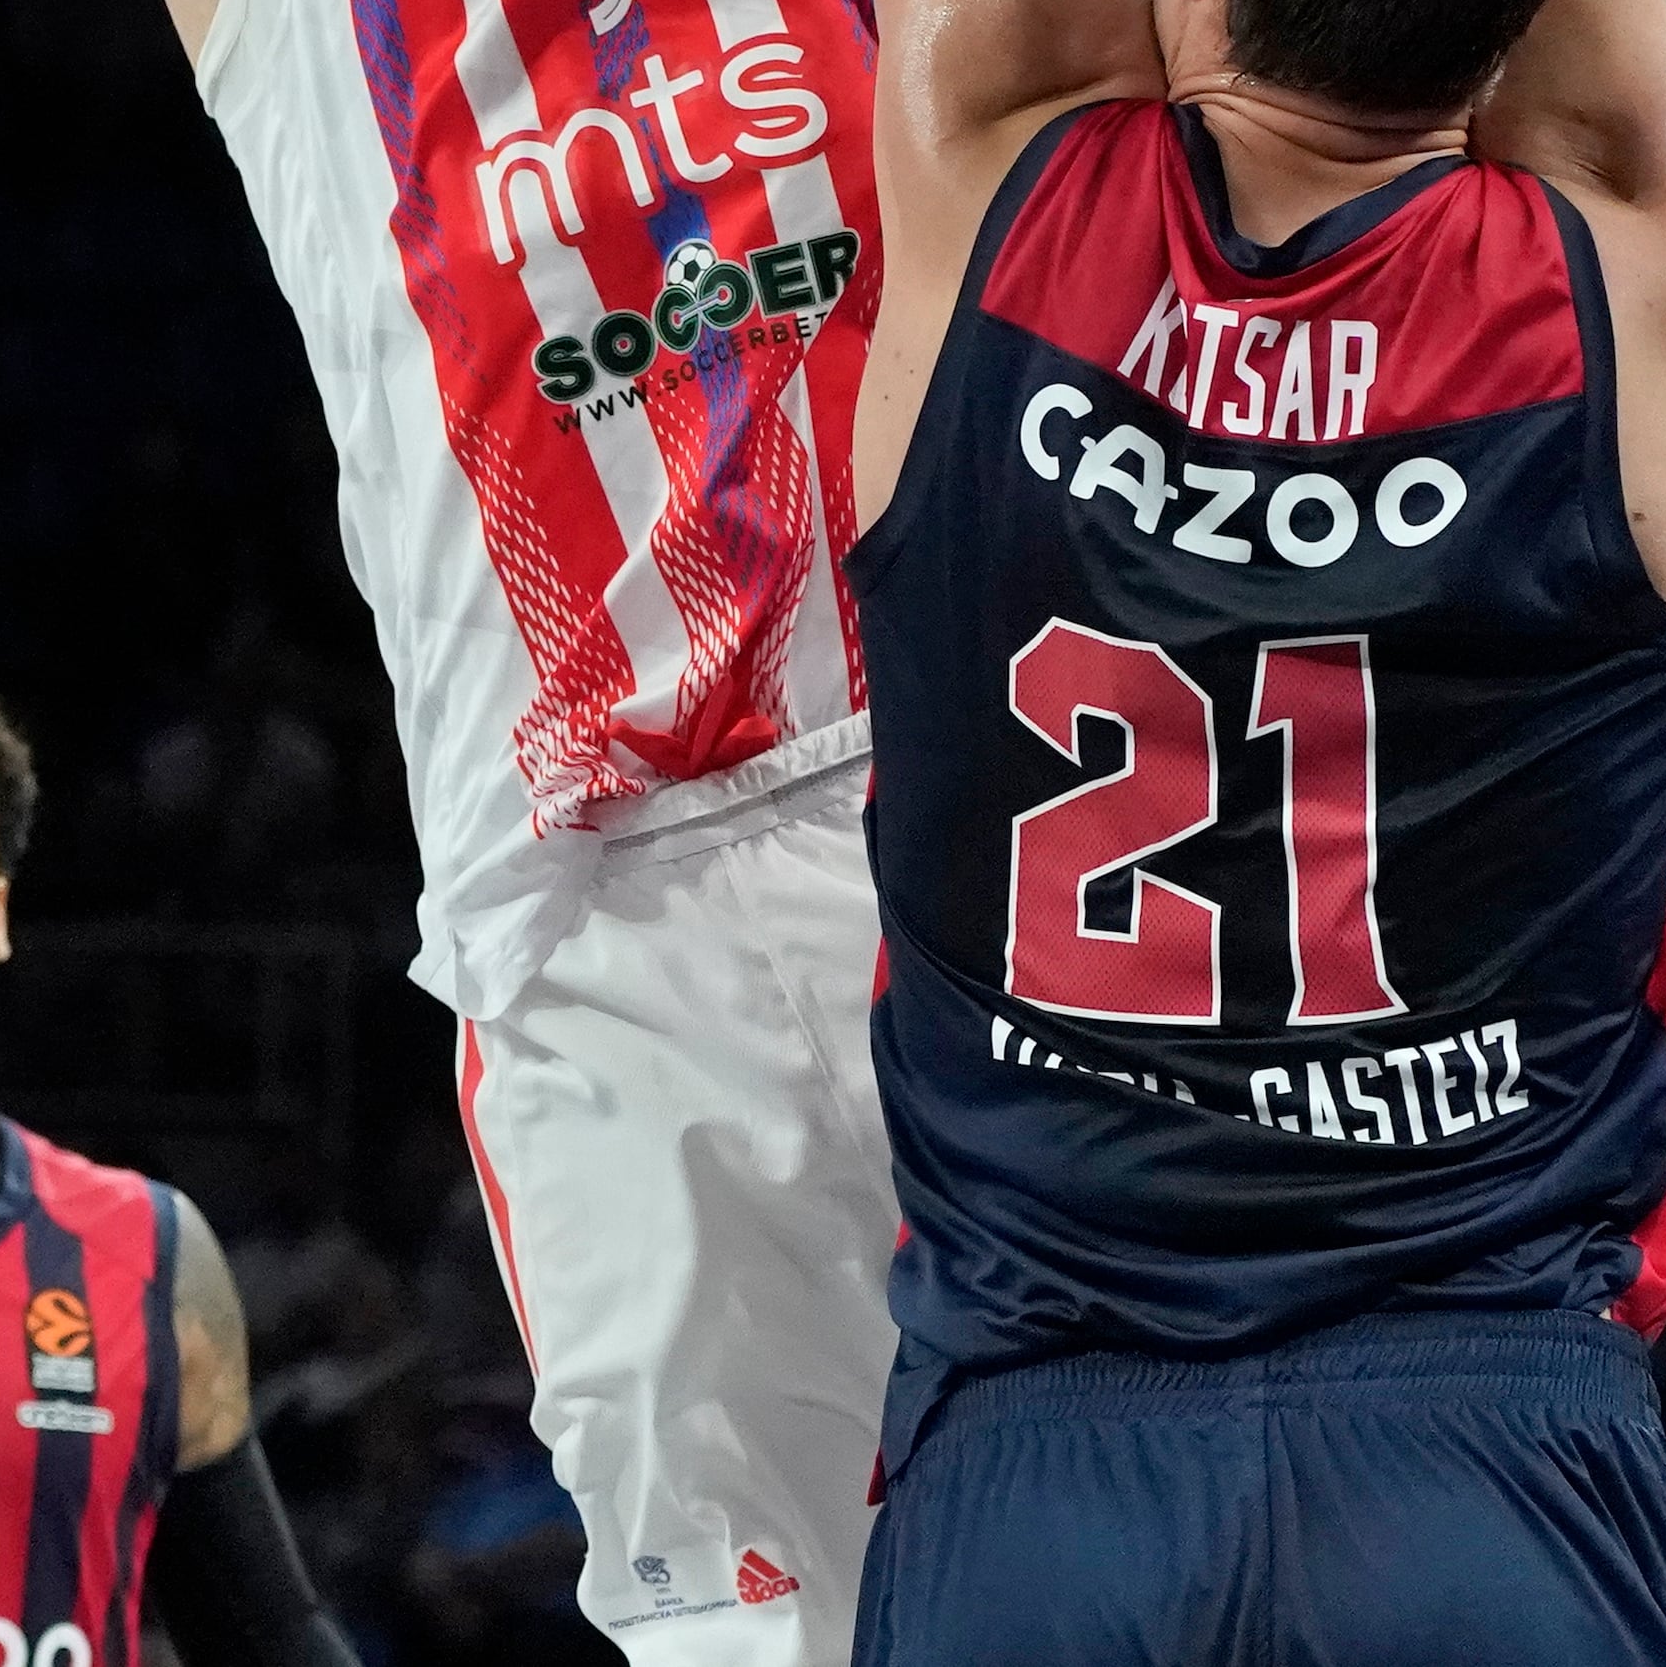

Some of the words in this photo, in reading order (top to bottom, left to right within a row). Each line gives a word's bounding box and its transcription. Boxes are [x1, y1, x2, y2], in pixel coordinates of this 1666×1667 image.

[475, 42, 829, 265] mts
[534, 230, 860, 403] SOCCER
[1020, 383, 1468, 569] CAZOO
[1004, 615, 1410, 1027] 21
